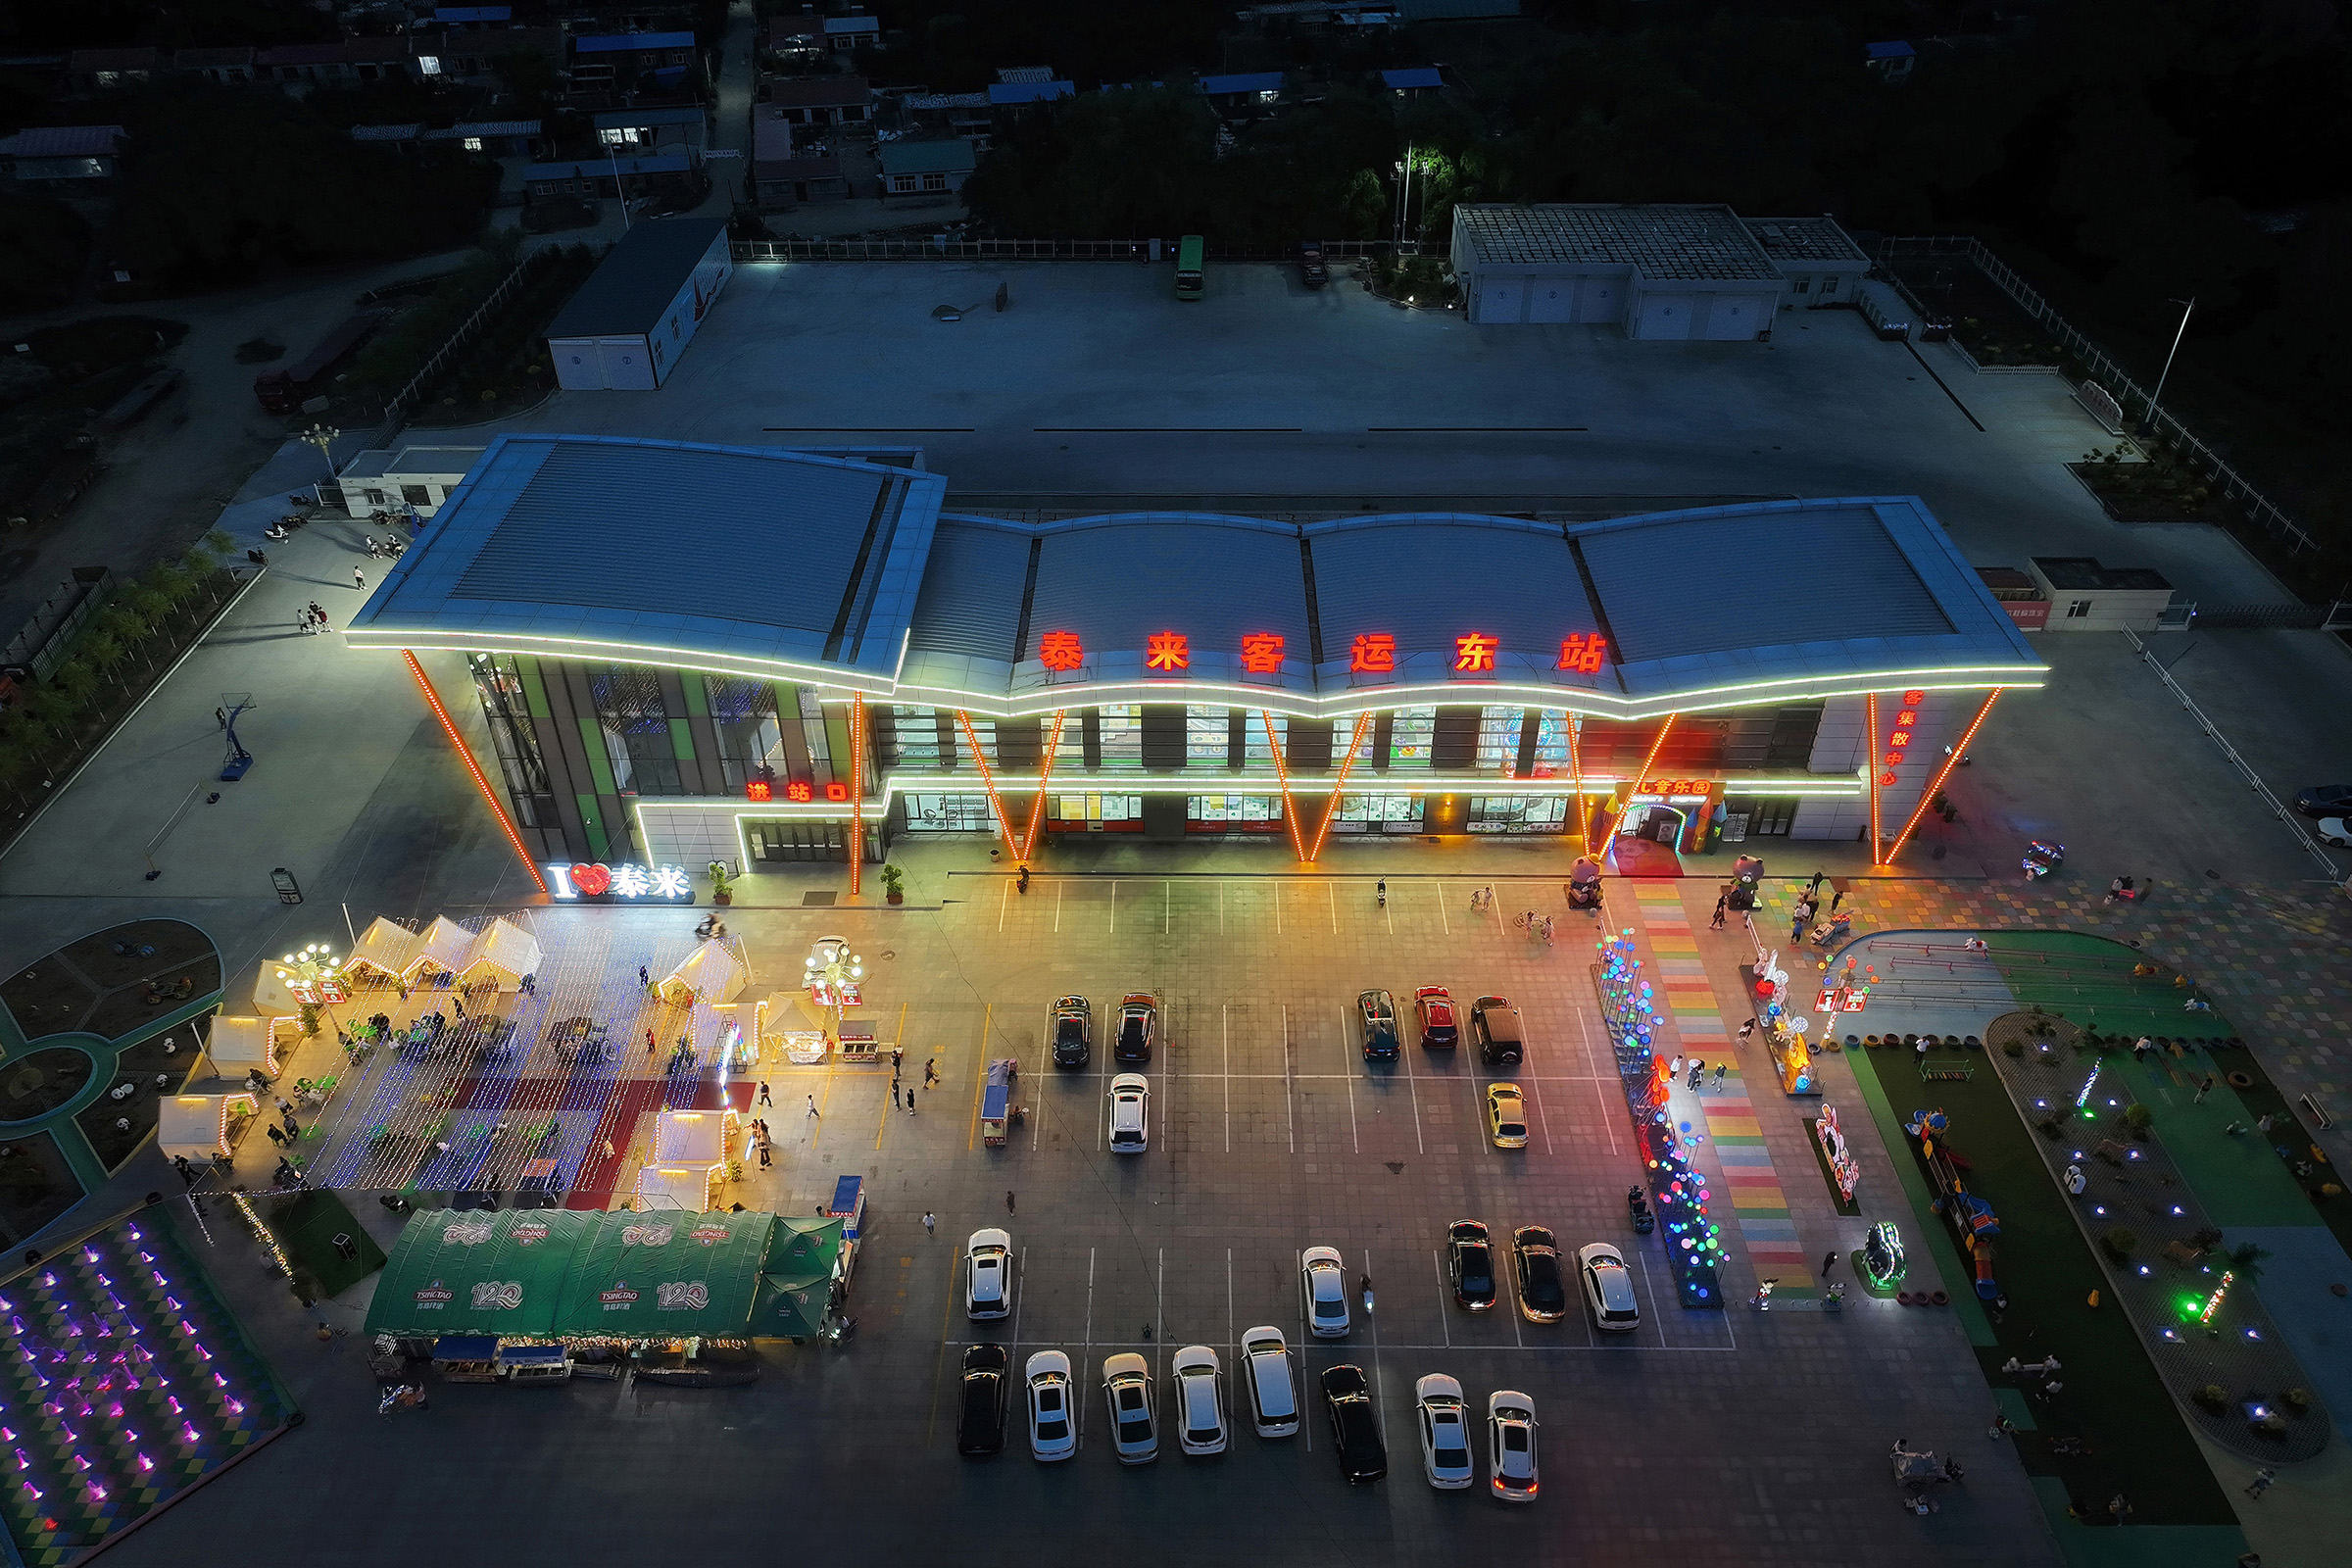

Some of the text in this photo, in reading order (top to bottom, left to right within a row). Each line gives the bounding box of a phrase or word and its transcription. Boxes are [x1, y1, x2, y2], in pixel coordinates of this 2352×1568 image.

[1039, 630, 1607, 673] 泰来客运东站
[747, 781, 848, 803] 进站口
[547, 862, 691, 899] I 泰来
[416, 1291, 453, 1300] TSINGTAO
[601, 1292, 638, 1300] TSINGTAO
